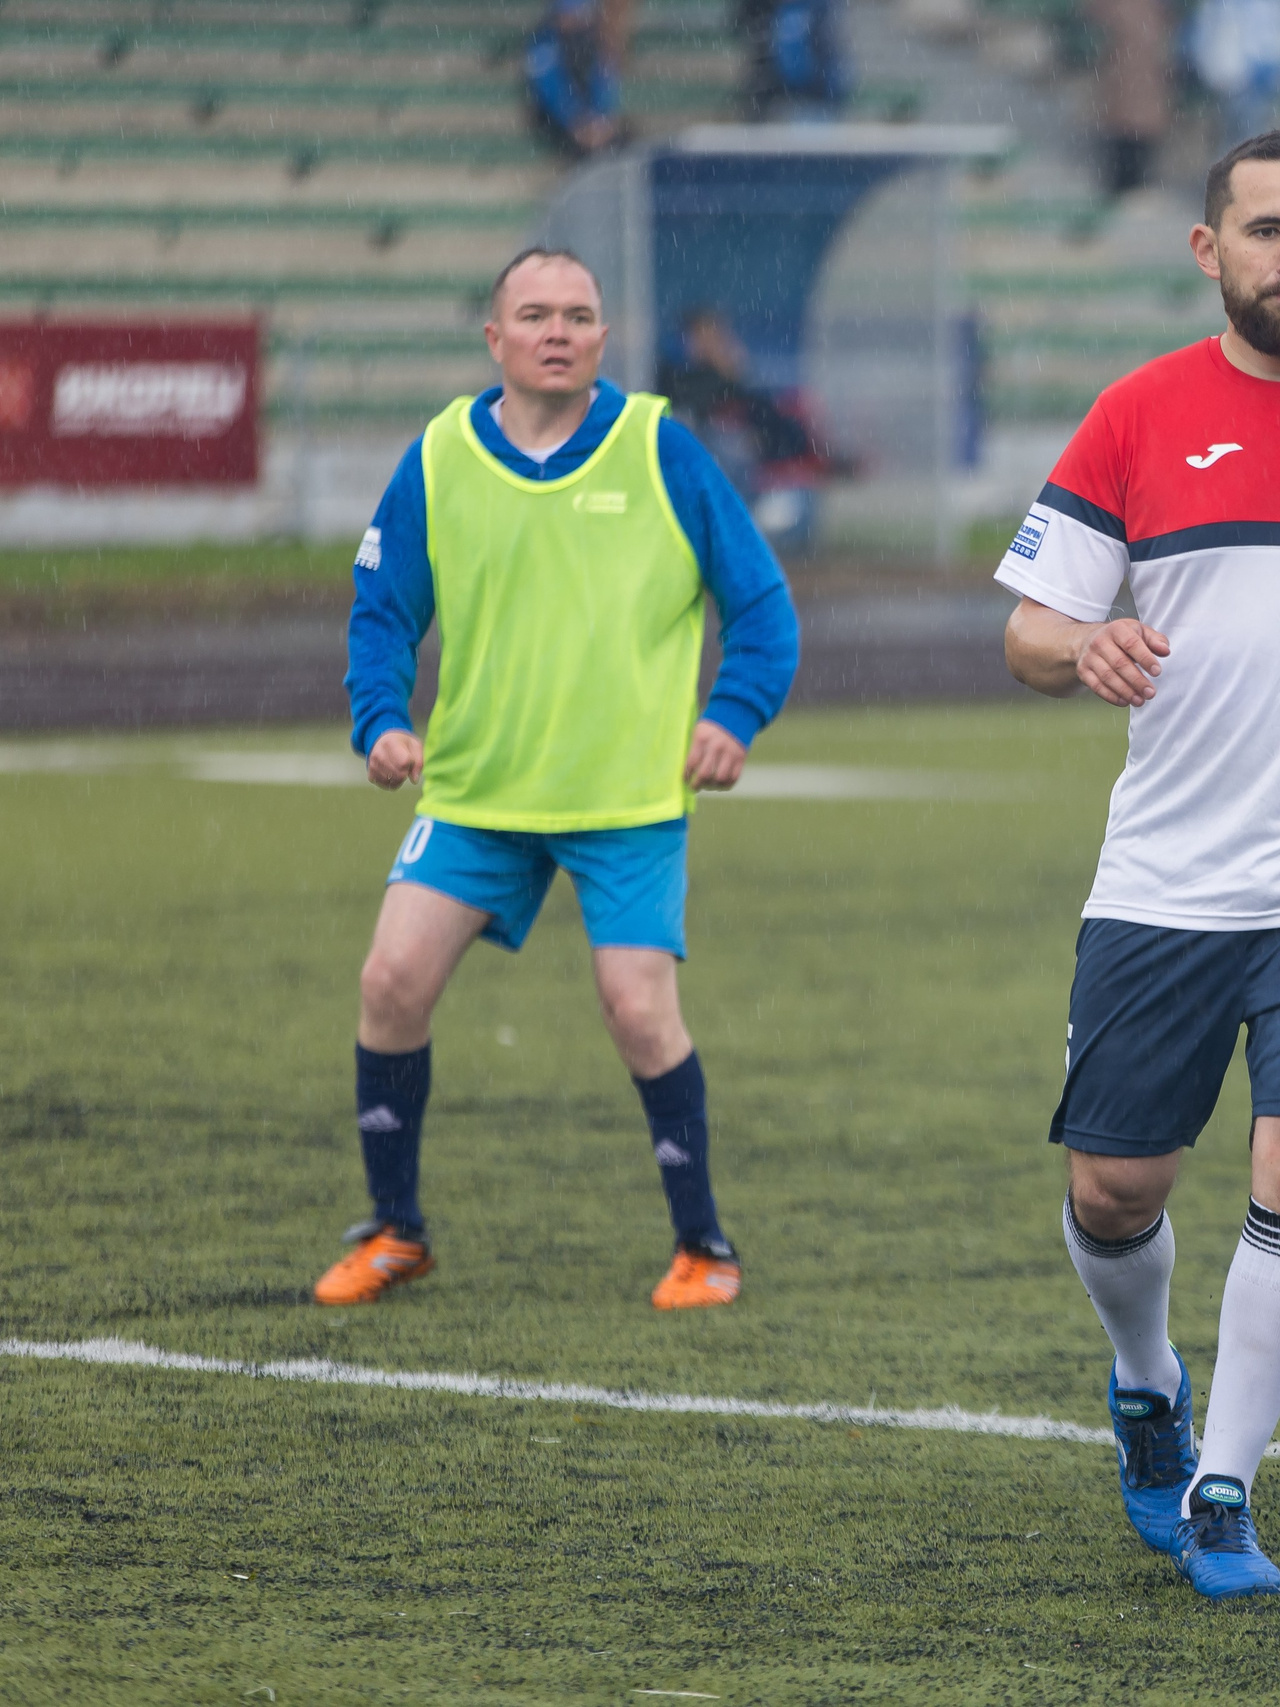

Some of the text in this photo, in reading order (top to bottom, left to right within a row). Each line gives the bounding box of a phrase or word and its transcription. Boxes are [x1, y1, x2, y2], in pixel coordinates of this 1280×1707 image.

[399, 817, 434, 865] 0
[1119, 1402, 1144, 1411] Joma
[1208, 1486, 1240, 1498] Joma
